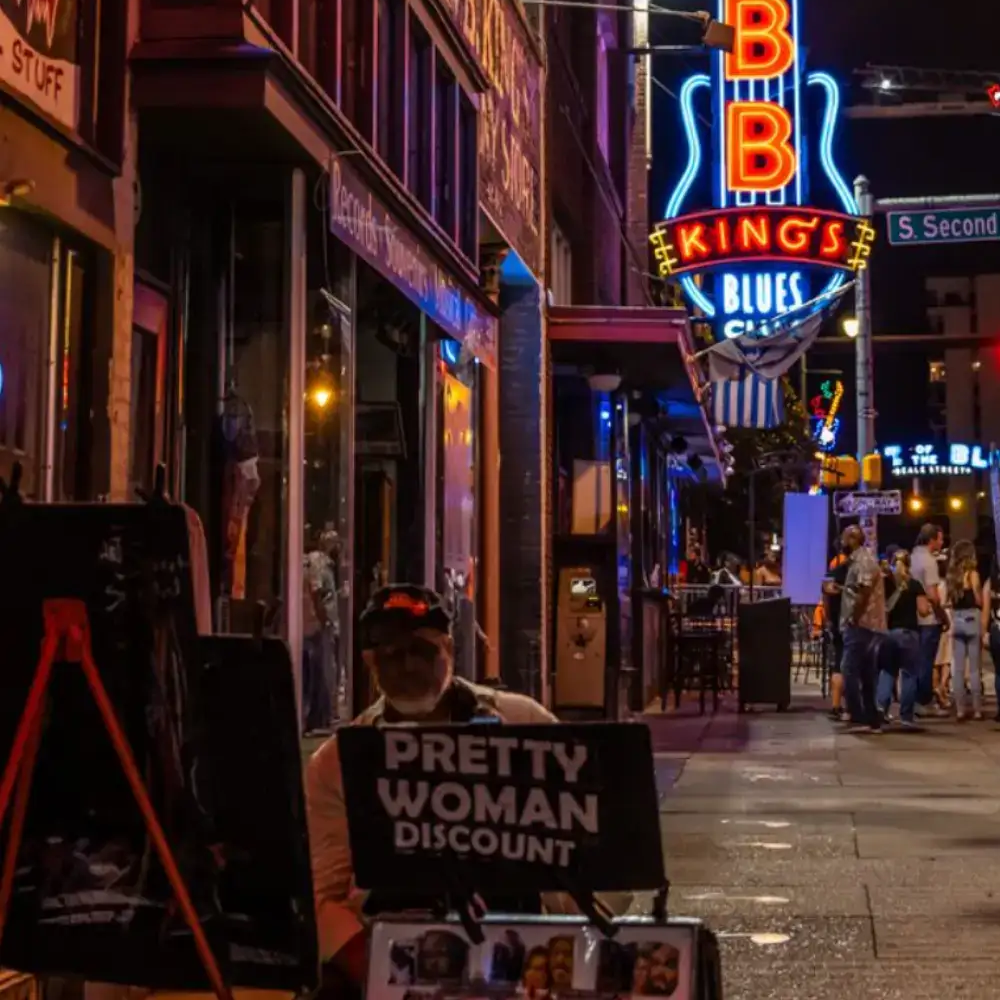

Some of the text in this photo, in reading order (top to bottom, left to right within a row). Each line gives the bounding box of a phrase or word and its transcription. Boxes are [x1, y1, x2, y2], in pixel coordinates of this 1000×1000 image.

[11, 39, 64, 106] STUFF
[898, 216, 918, 240] S.
[922, 212, 998, 239] Second
[722, 271, 802, 315] BLUES
[911, 454, 938, 465] THE
[915, 444, 934, 454] OF
[384, 731, 588, 783] PRETTY
[376, 777, 599, 834] WOMAN
[394, 821, 576, 868] DISCOUNT
